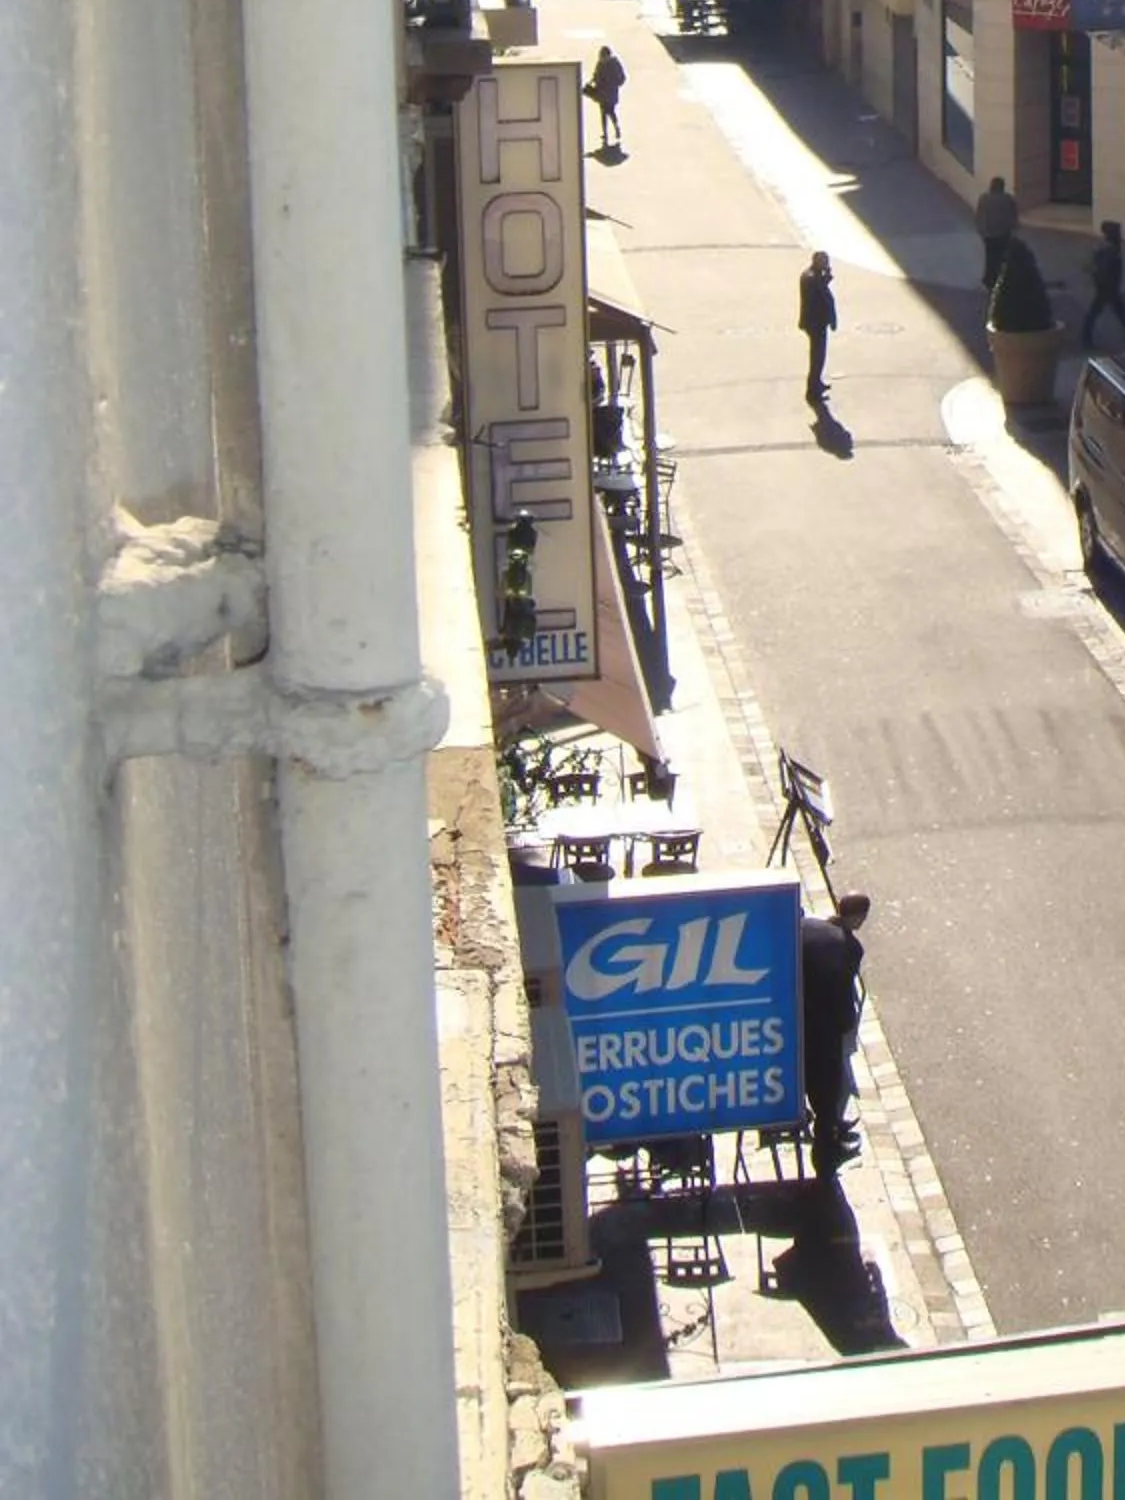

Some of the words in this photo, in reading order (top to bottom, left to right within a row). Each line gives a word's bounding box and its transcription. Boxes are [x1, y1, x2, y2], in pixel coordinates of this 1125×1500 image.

[478, 76, 577, 633] HOTEL
[565, 911, 771, 1001] GIL
[577, 1017, 785, 1073] ERRUQUES
[580, 1067, 786, 1122] OSTICHES
